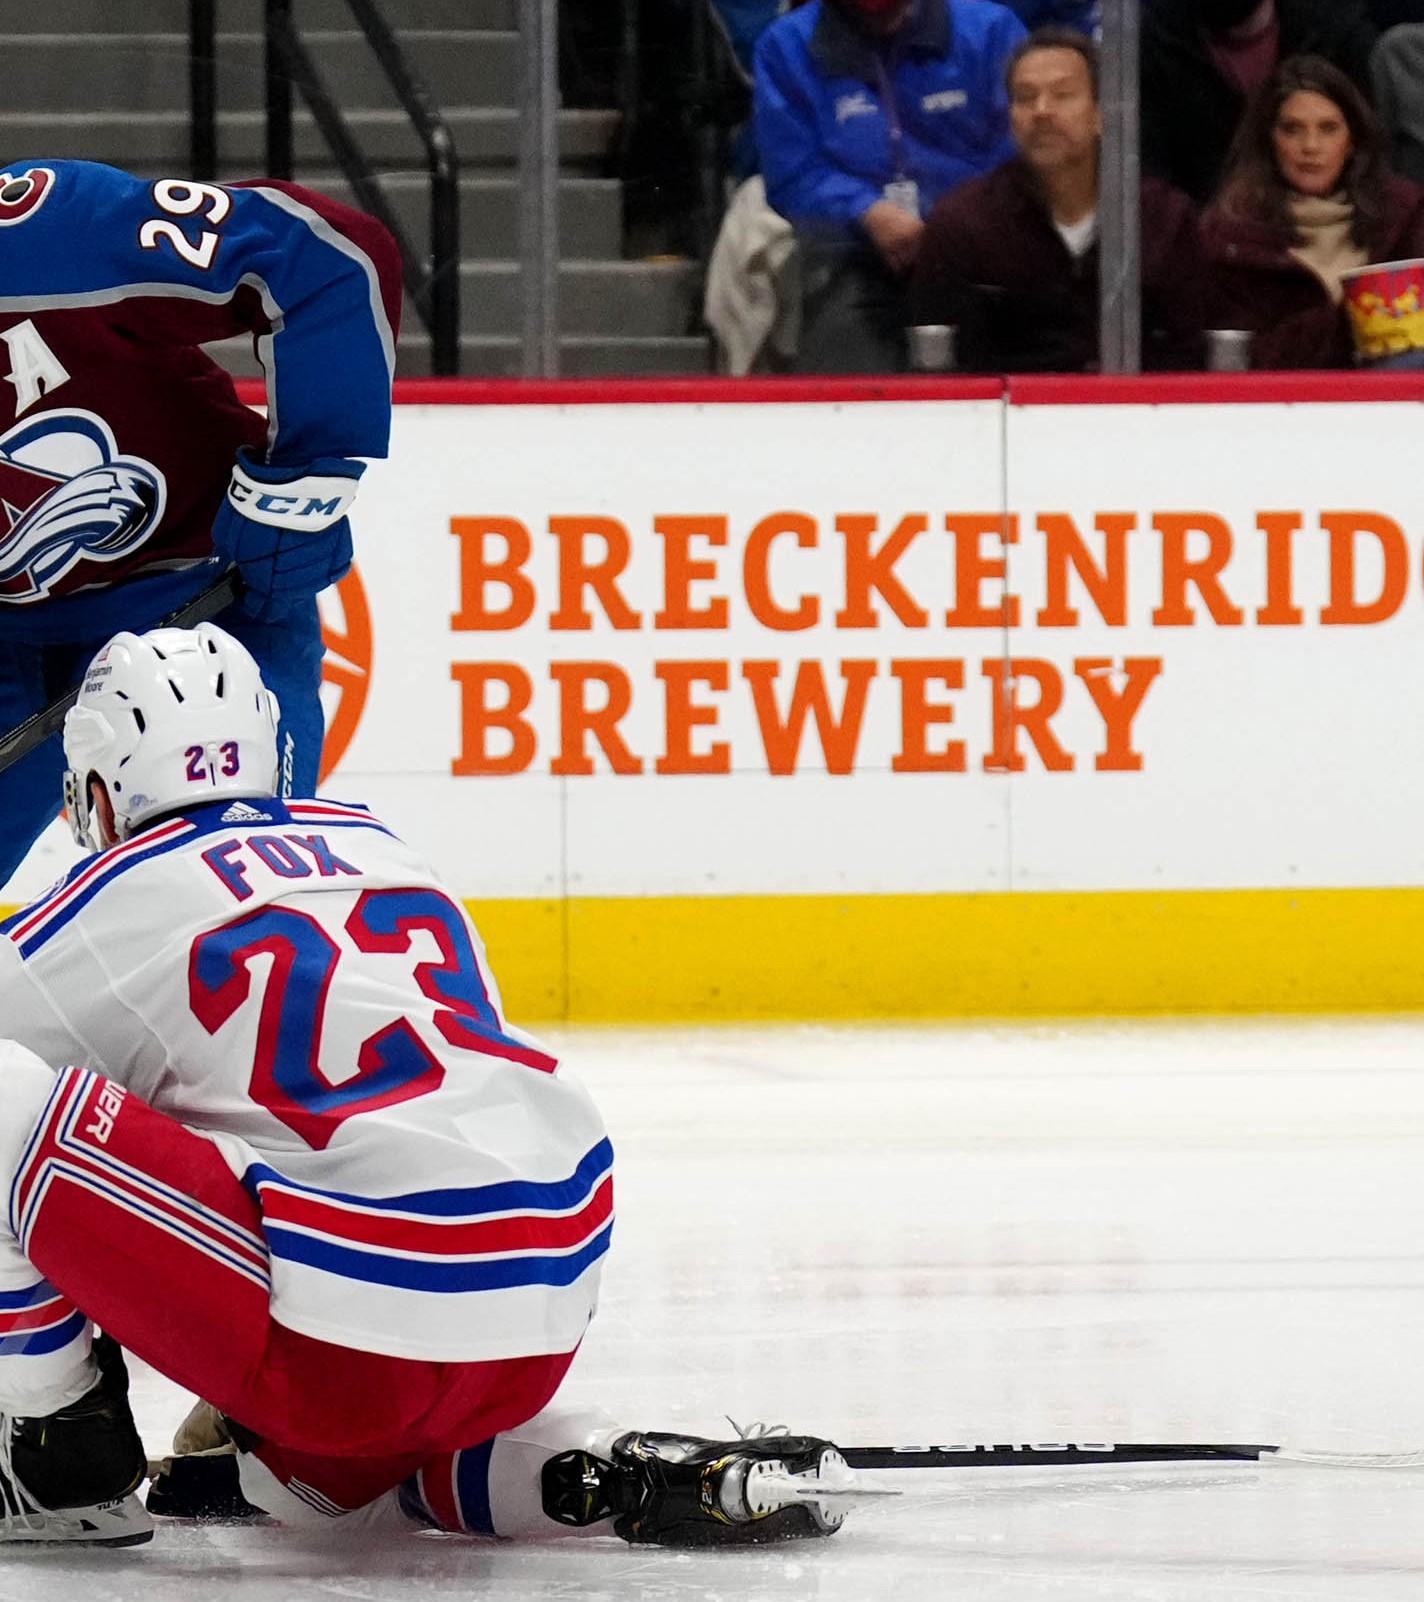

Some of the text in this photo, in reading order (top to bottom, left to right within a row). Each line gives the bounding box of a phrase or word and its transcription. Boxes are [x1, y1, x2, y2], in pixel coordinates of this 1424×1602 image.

[139, 178, 231, 270] 29
[229, 477, 345, 517] CCM
[449, 511, 1424, 632] BRECKENRID
[450, 657, 1164, 777] BREWERY
[184, 741, 240, 781] 23
[220, 811, 273, 822] adidas
[201, 833, 363, 902] FOX
[188, 886, 559, 1151] 23
